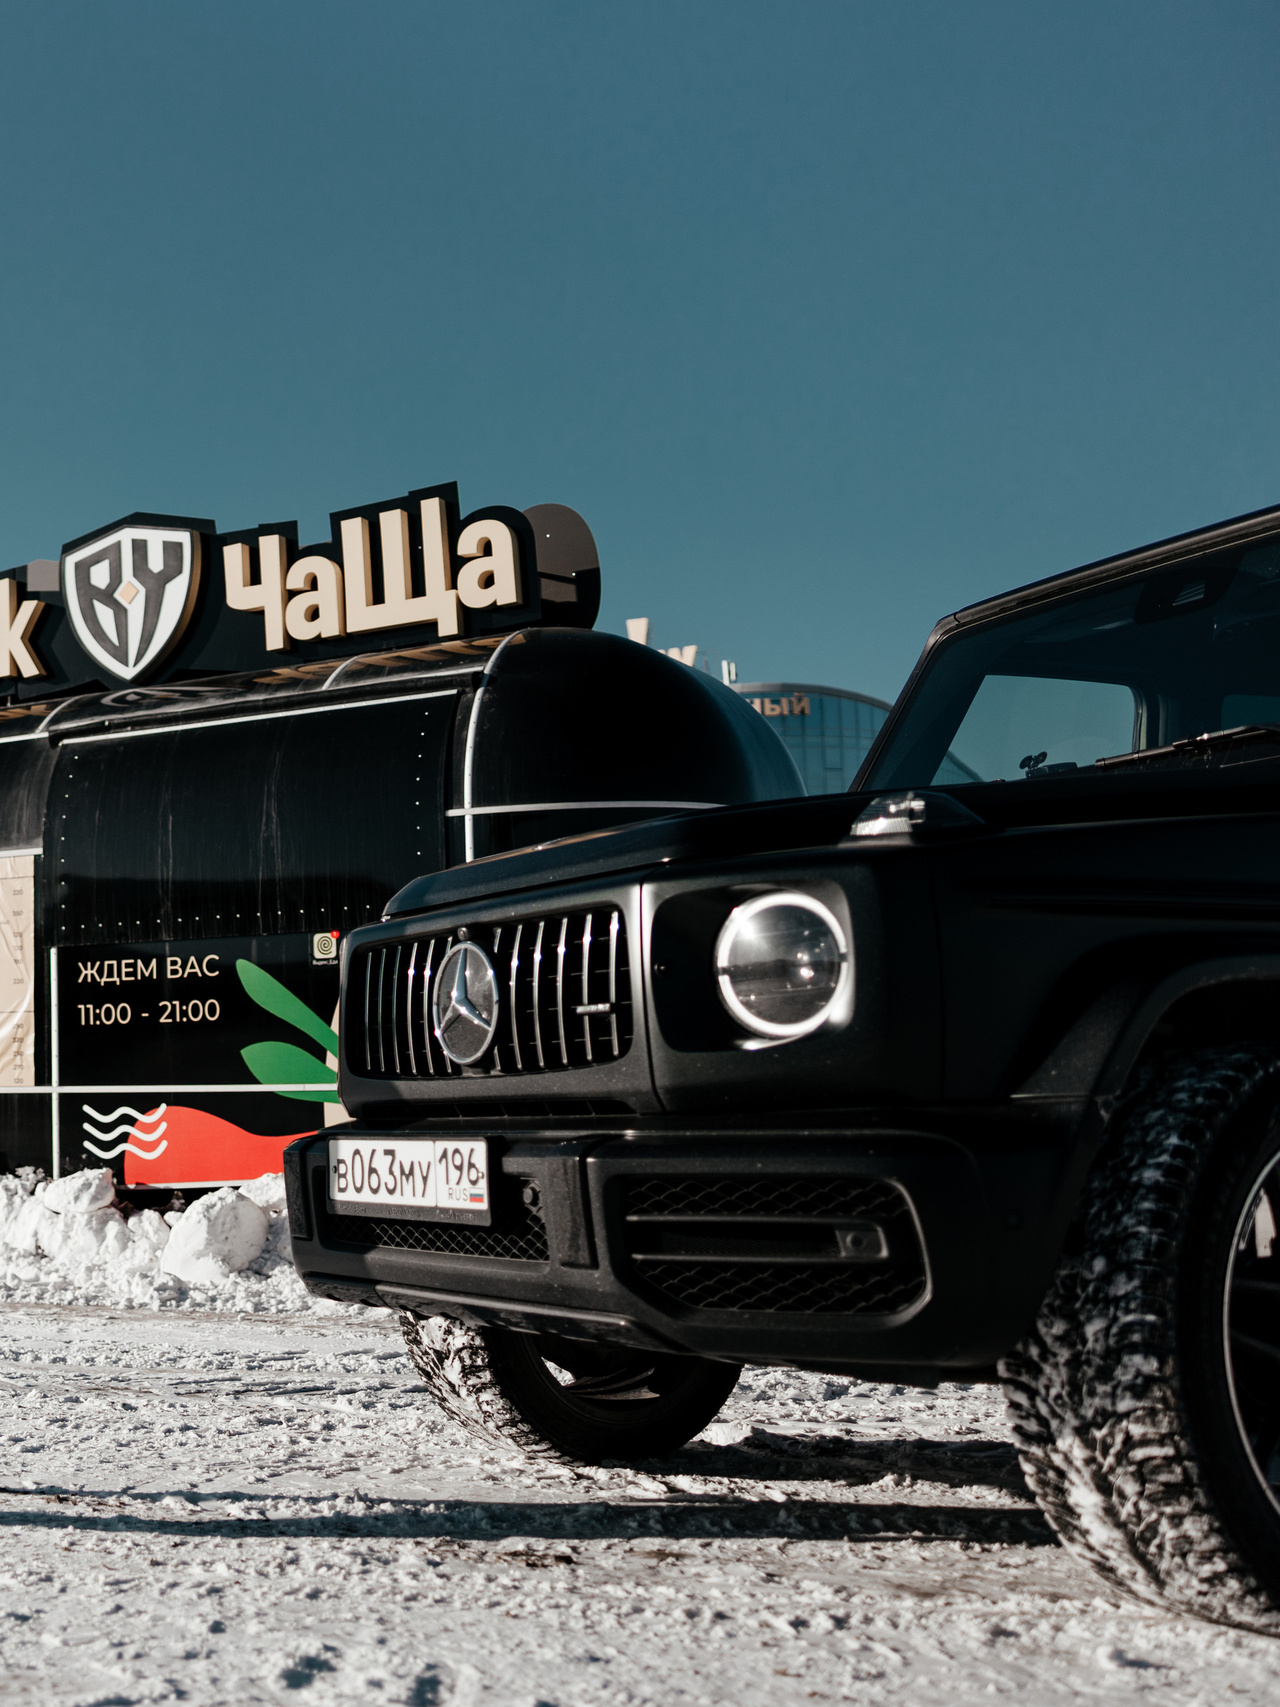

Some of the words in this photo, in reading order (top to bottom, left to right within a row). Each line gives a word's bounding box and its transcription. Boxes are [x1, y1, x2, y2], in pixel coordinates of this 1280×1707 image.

[77, 958, 157, 986] ЖДЕМ
[166, 954, 220, 980] ВАС
[77, 1002, 132, 1026] 11:00
[158, 999, 220, 1023] 21:00
[438, 1147, 480, 1187] 196
[448, 1187, 469, 1202] RUS
